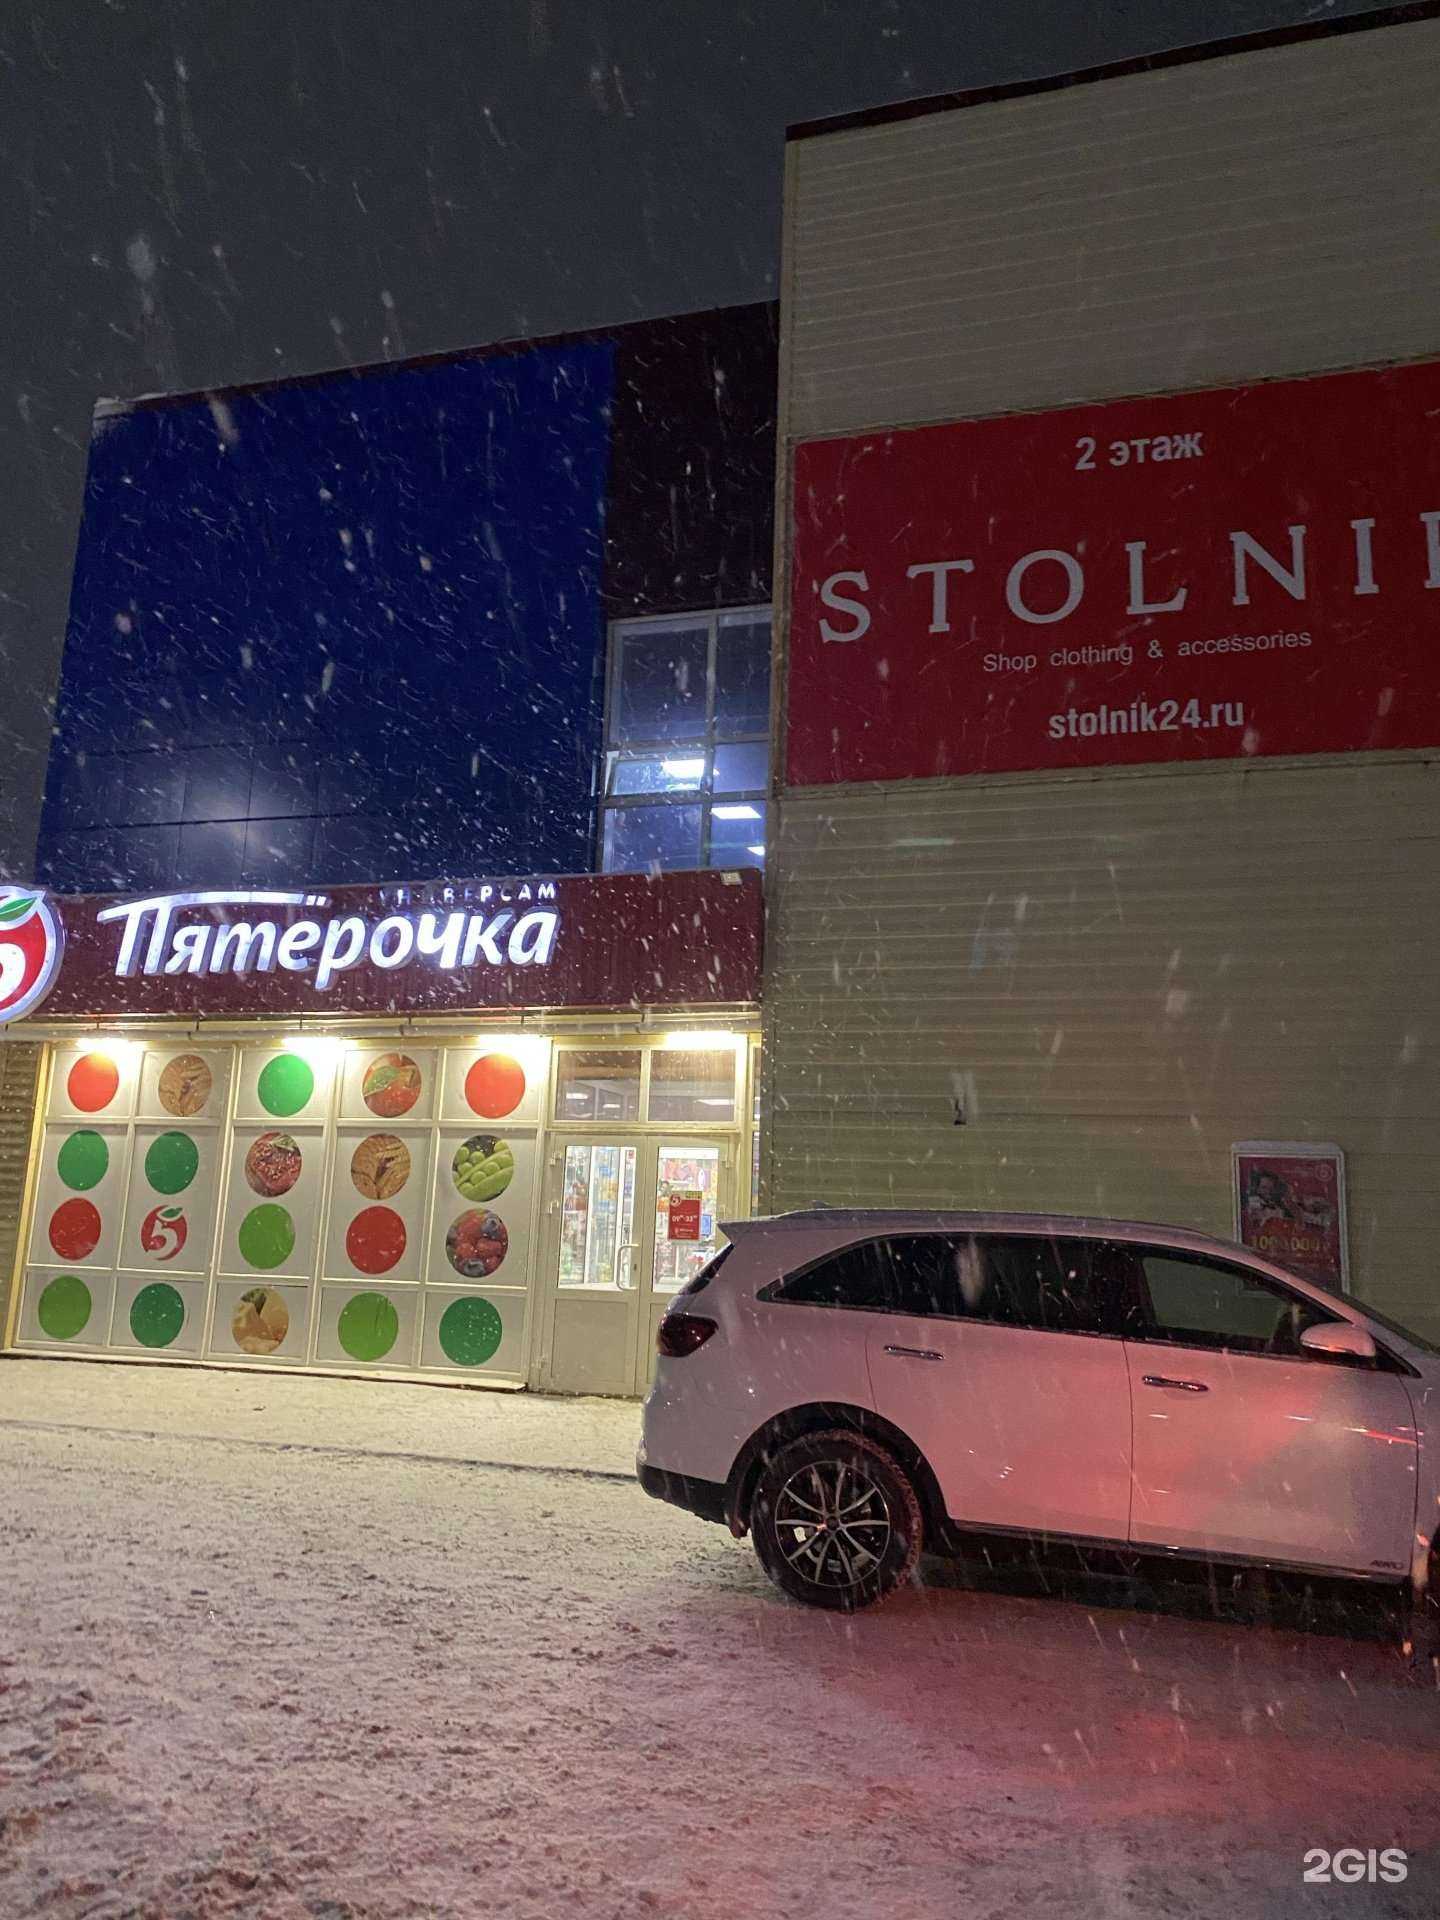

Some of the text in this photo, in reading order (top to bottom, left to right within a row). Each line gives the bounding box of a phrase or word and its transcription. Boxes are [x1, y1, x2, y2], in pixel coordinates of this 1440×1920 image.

[1075, 432, 1204, 470] 2 этаж
[819, 511, 1440, 643] STOLNI
[983, 630, 1312, 672] Shop clothing & accessories
[1049, 699, 1244, 738] stolnik24.ru
